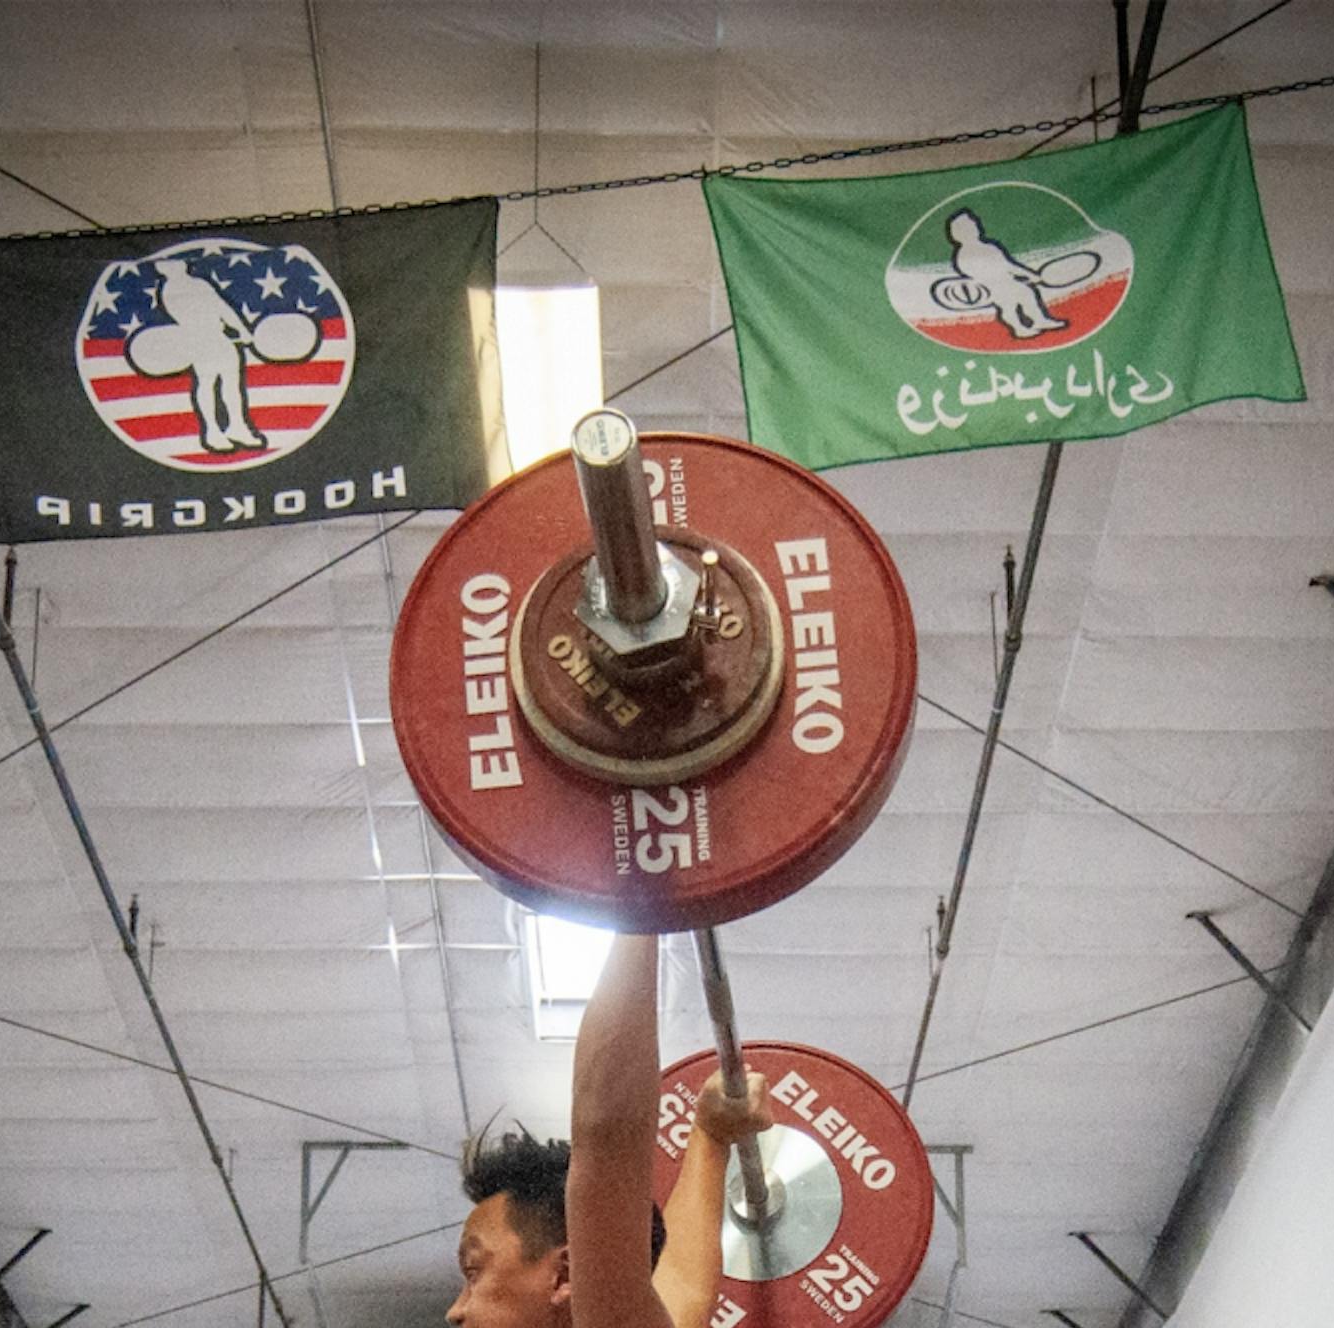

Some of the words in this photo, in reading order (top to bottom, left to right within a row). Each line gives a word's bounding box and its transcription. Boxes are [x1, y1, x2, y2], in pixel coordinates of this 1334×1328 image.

[460, 573, 524, 790] ELEIKO
[774, 536, 844, 754] ELEIKO
[611, 794, 631, 877] SWEDEN
[632, 786, 693, 874] 25
[693, 786, 712, 862] TRAINING
[657, 1093, 697, 1149] 25
[769, 1070, 897, 1191] ELEIKO
[798, 1279, 845, 1324] SWEDEN
[807, 1253, 874, 1313] 25
